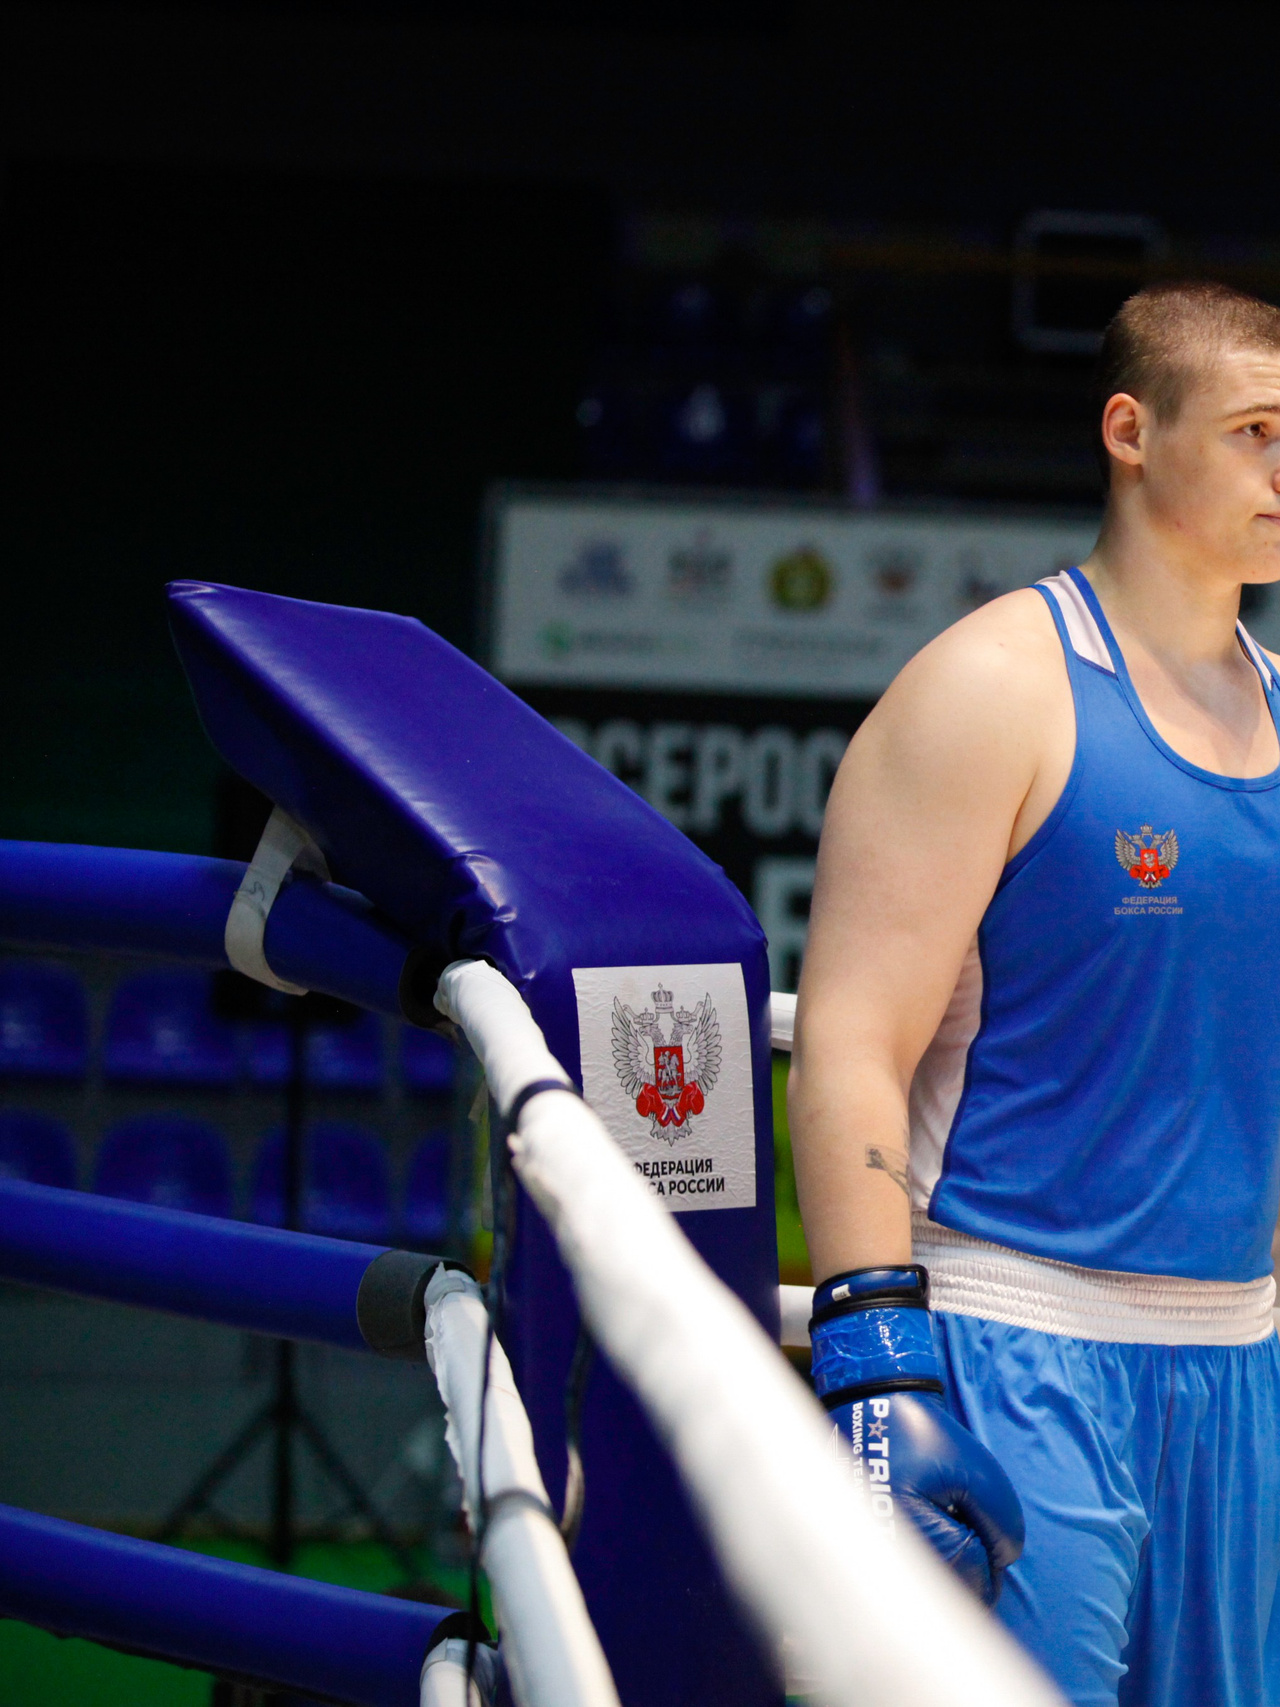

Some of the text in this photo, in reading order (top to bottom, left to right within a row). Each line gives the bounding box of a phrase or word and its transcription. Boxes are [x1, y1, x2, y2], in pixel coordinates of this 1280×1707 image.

[1121, 896, 1178, 905] ФЕДЕРАЦИЯ
[1114, 907, 1183, 915] БОКСА РОССИИ
[669, 1177, 725, 1195] РОССИИ
[852, 1401, 864, 1455] BOXING
